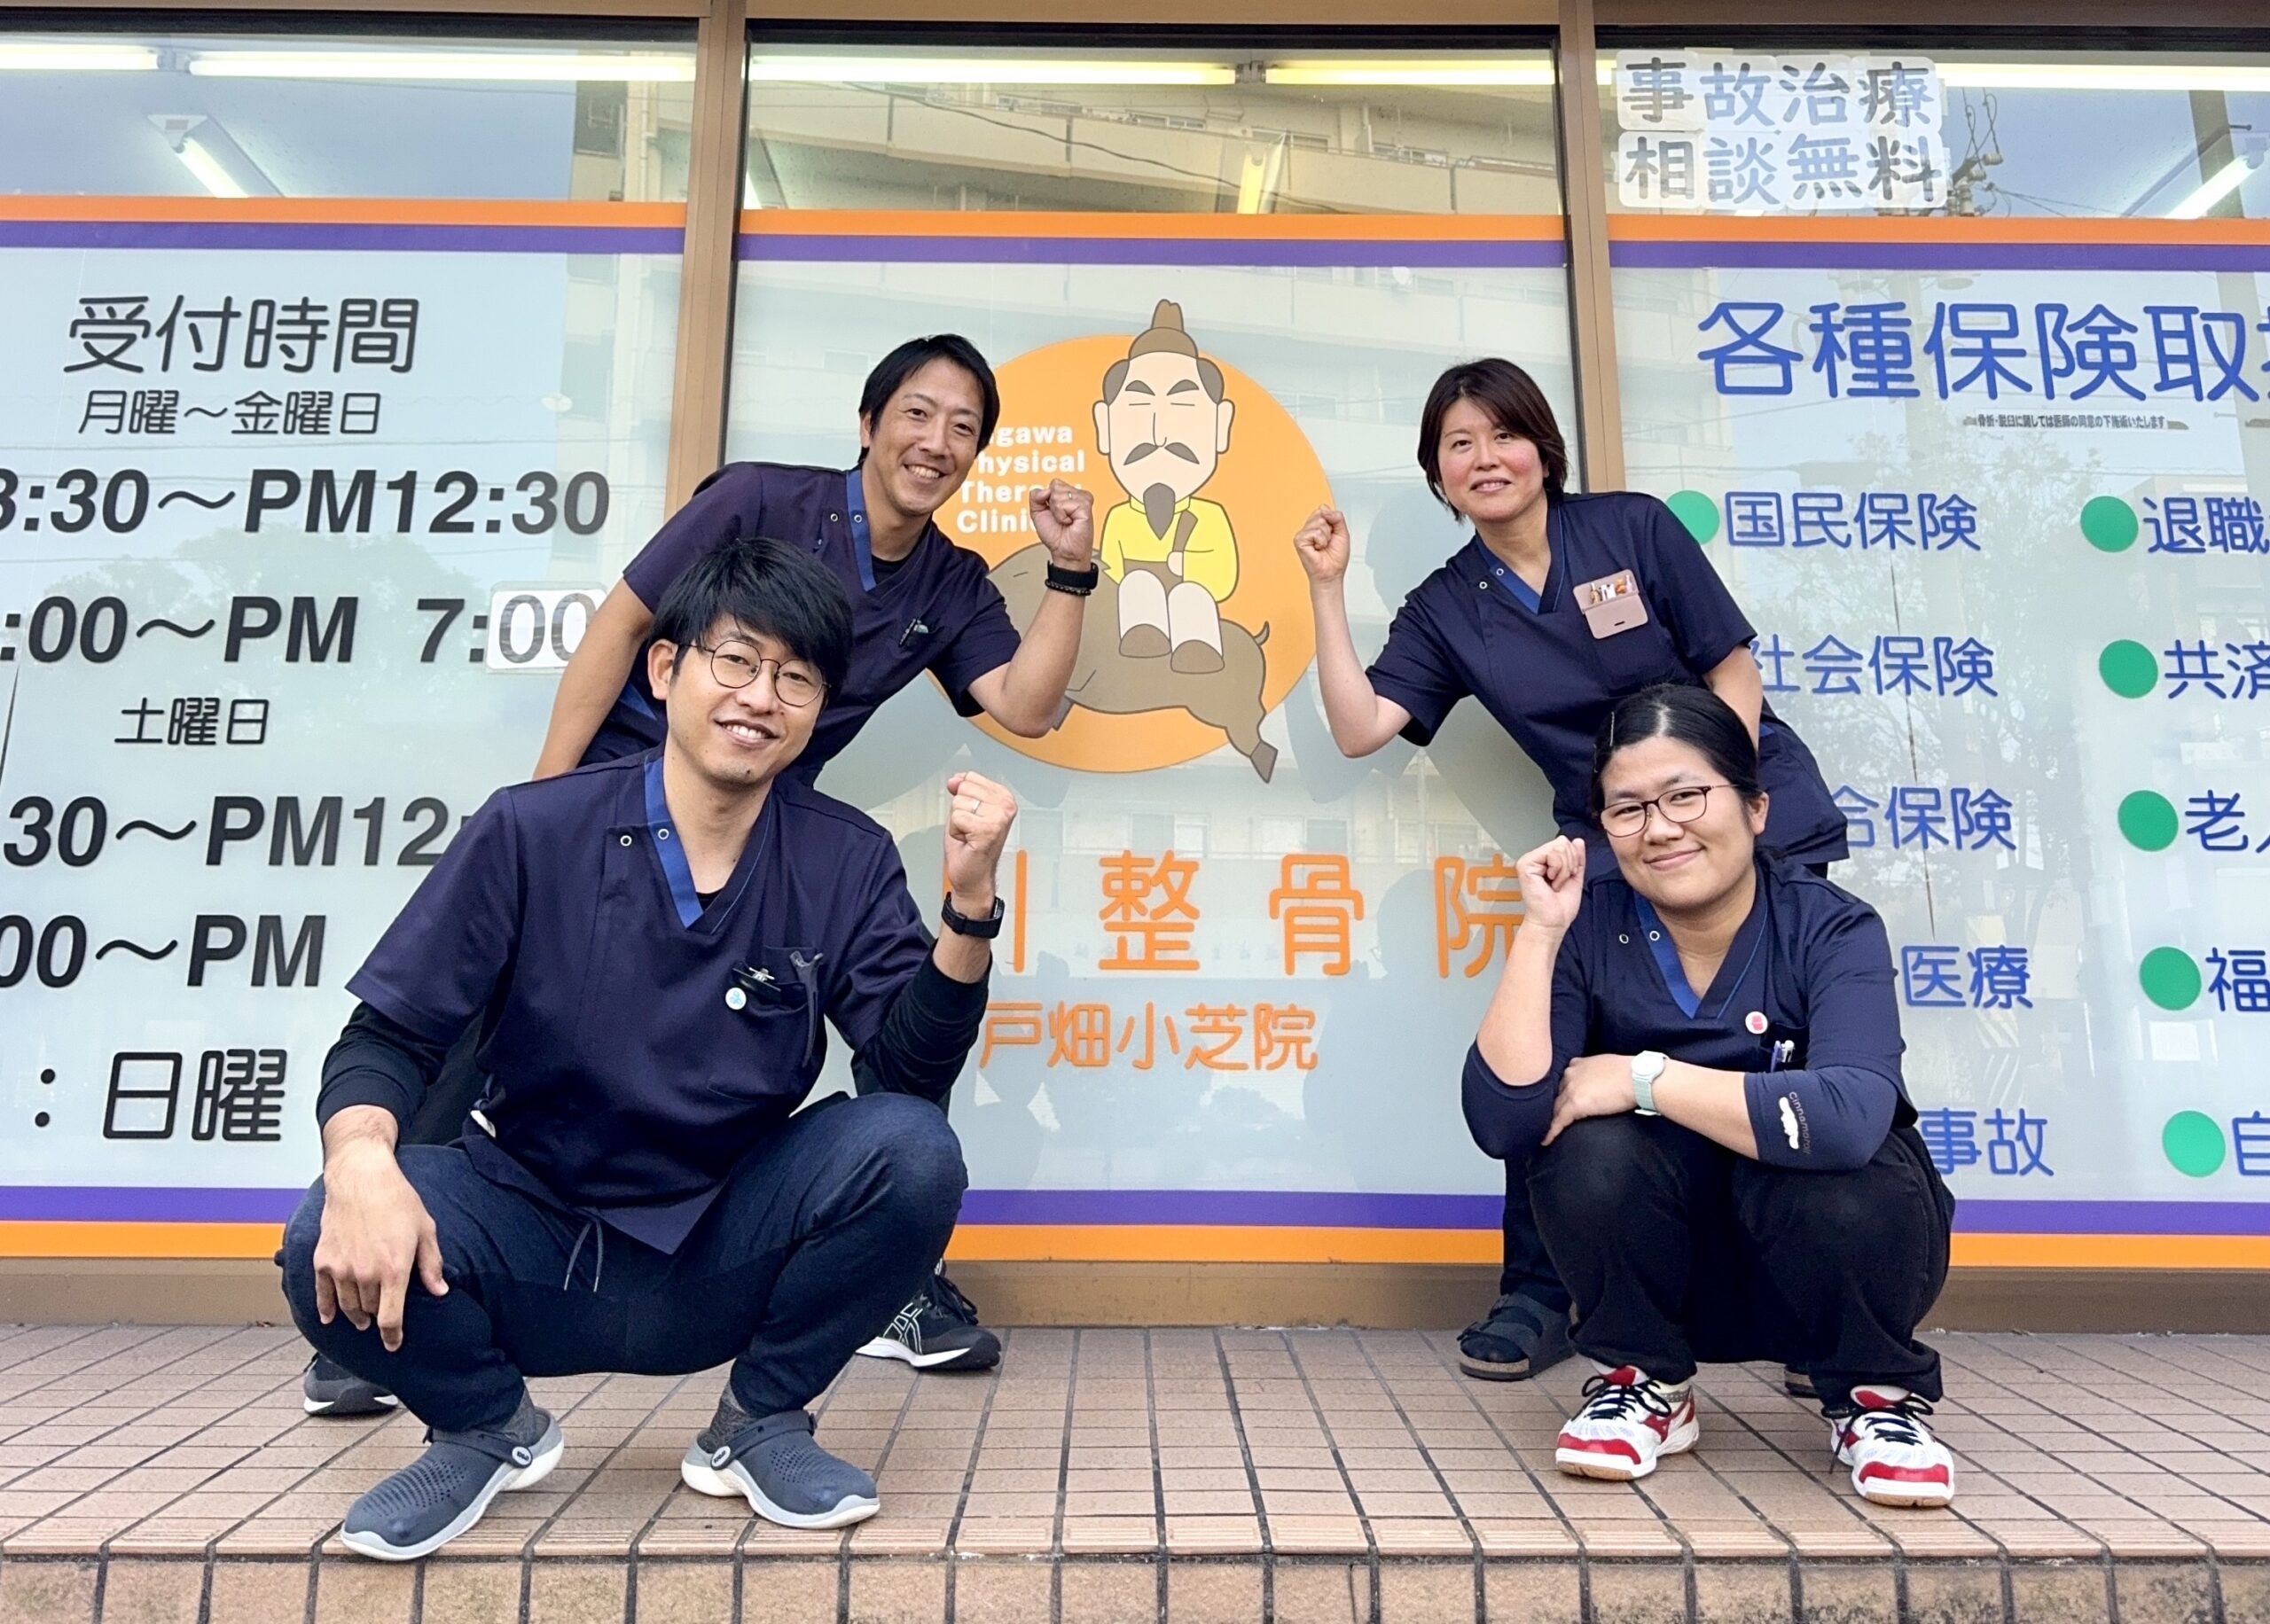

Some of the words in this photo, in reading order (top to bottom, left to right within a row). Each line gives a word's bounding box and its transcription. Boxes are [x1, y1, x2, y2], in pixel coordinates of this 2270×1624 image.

[1622, 57, 1935, 128] 事故治療
[1624, 133, 1943, 206] 相談無料
[63, 294, 419, 373] 受付時間
[1697, 301, 2270, 402] 各種保険取
[78, 389, 382, 435] 月曜～金曜日
[989, 426, 1073, 448] gawa
[977, 449, 1085, 477] hysical
[957, 509, 1037, 534] Clini
[1725, 491, 1981, 551] 国民保険
[416, 592, 598, 664] 7:00
[1750, 634, 1999, 698] 社会保険
[114, 697, 270, 747] 土曜日
[2185, 789, 2270, 854] 老
[1901, 944, 2033, 1010] 医療
[2205, 948, 2270, 1012] 福
[979, 1002, 1319, 1072] 戸畑小芝院
[1918, 1107, 2055, 1176] 事故
